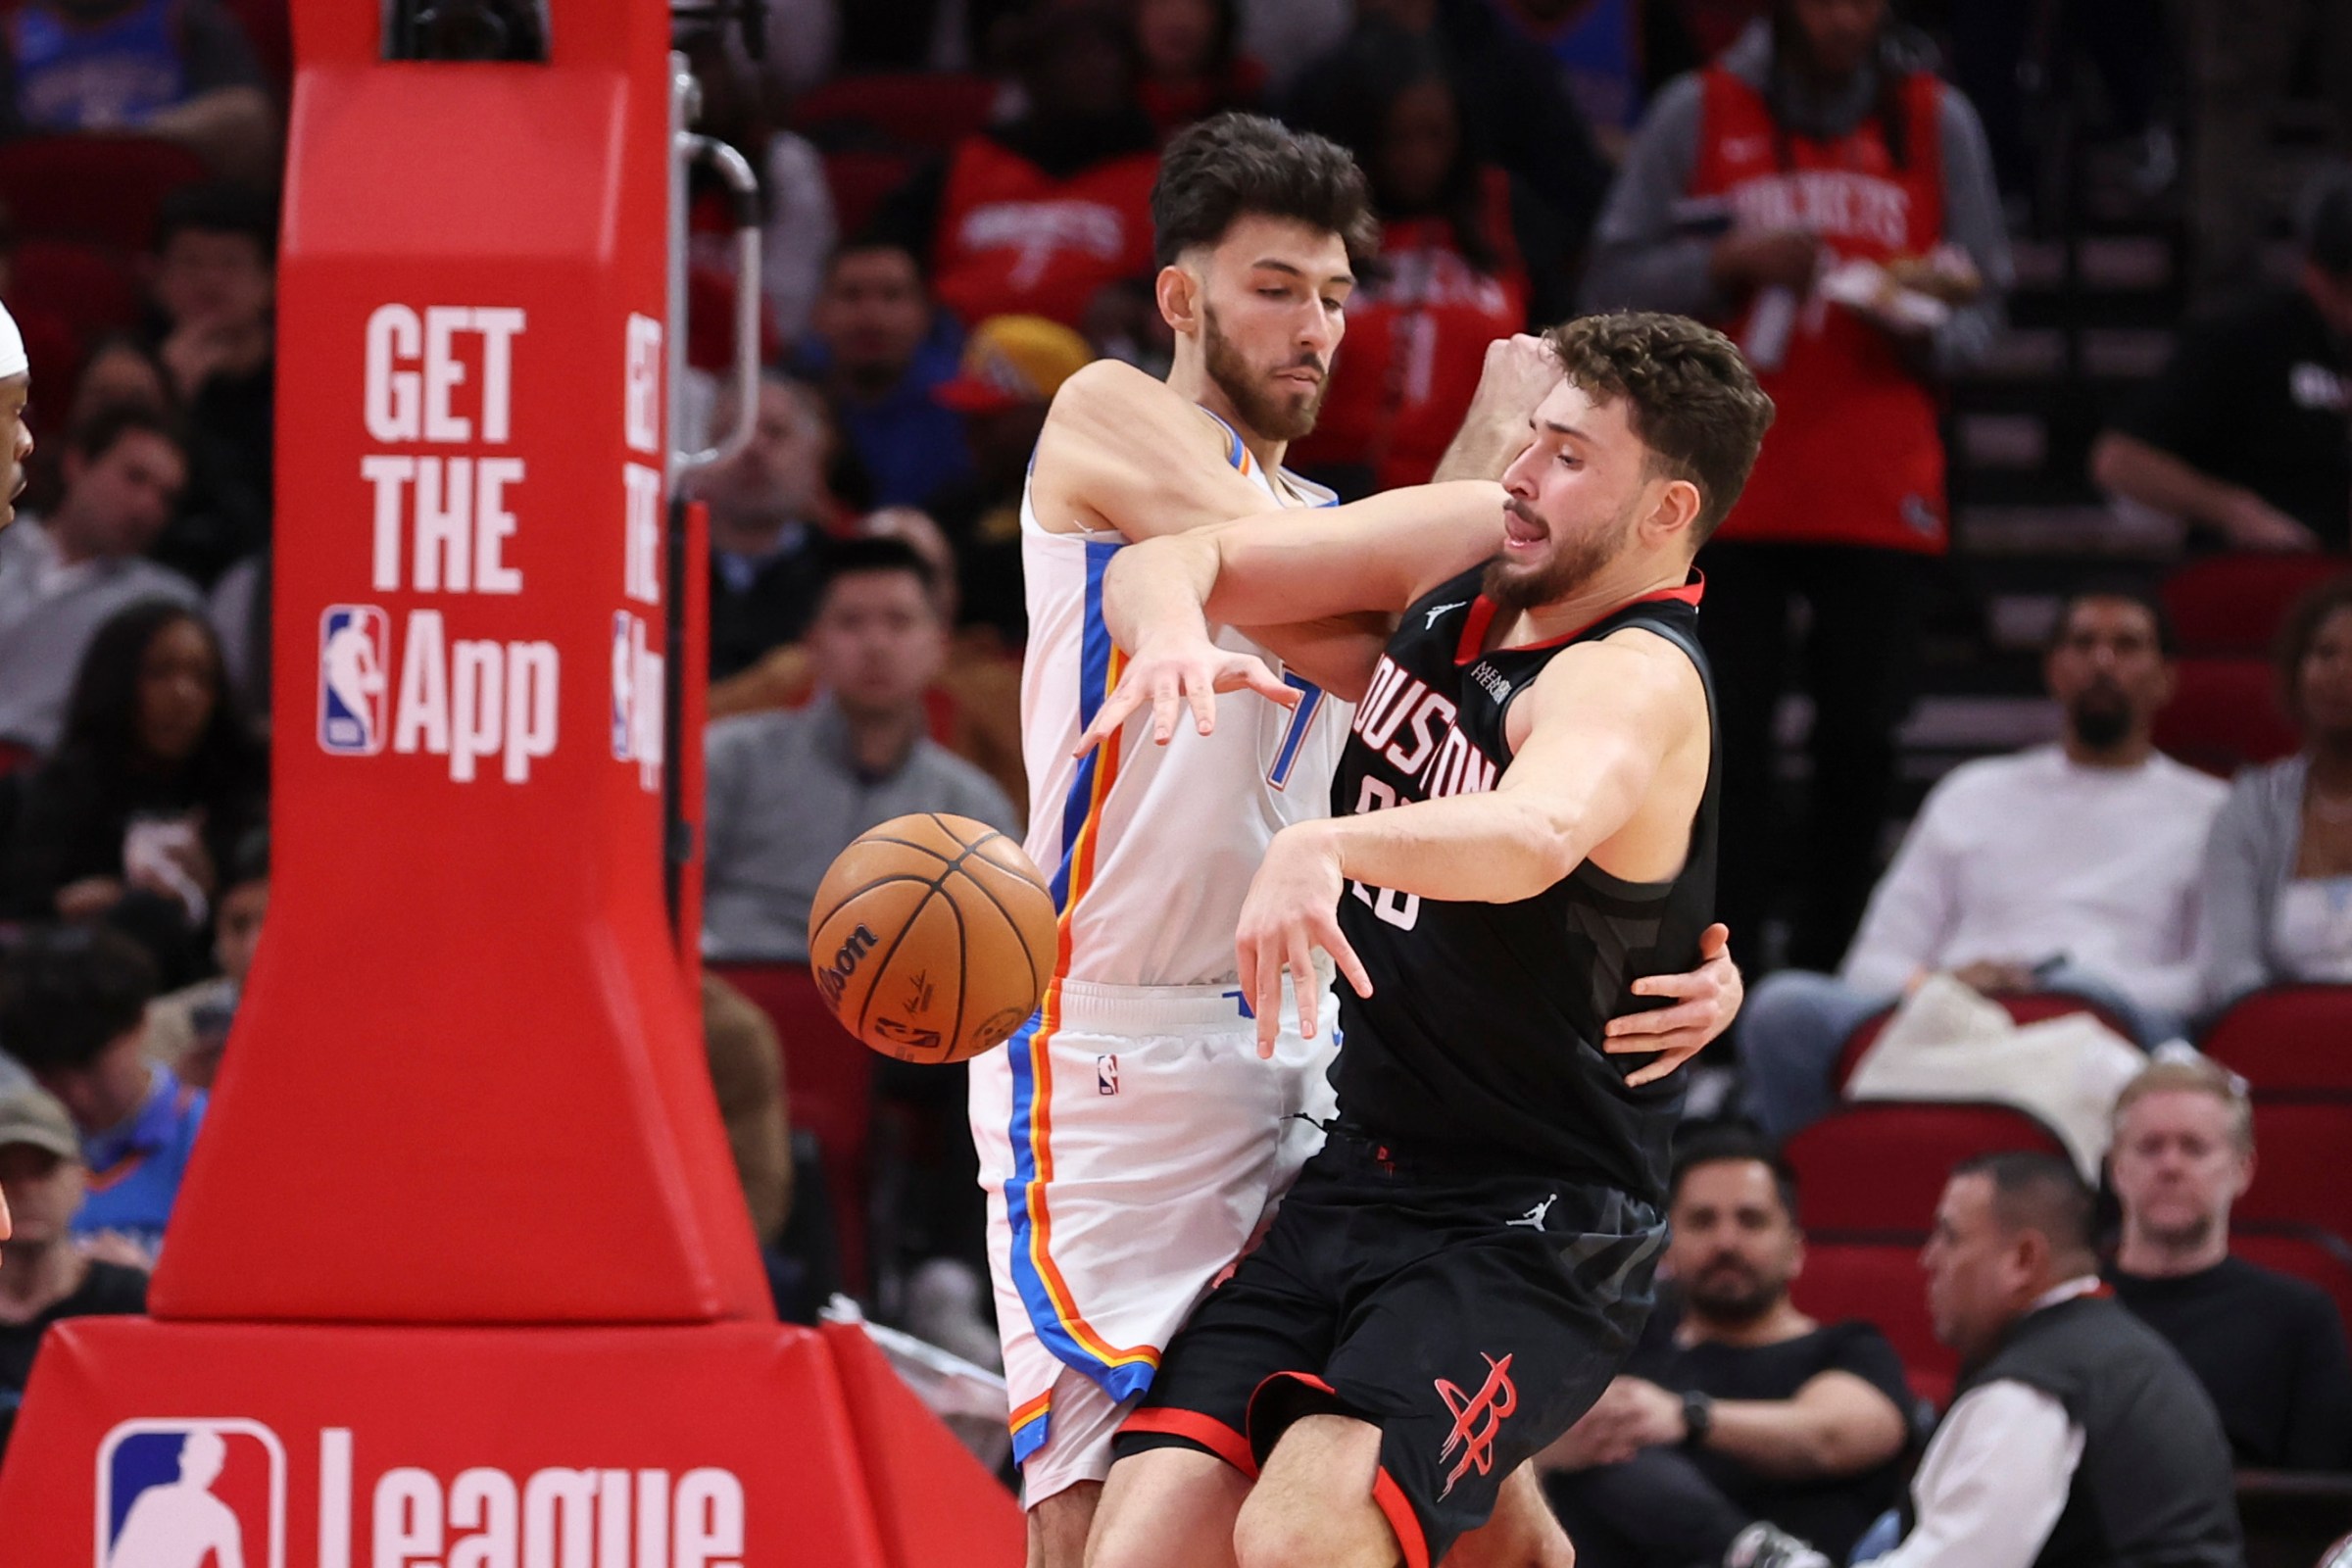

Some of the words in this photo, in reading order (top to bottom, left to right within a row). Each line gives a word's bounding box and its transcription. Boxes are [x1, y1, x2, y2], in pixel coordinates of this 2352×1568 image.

[364, 303, 526, 443] GET
[360, 456, 525, 595] THE
[393, 608, 560, 784] App
[1266, 663, 1328, 792] 7
[1352, 652, 1498, 802] OUSON
[318, 1427, 745, 1568] League
